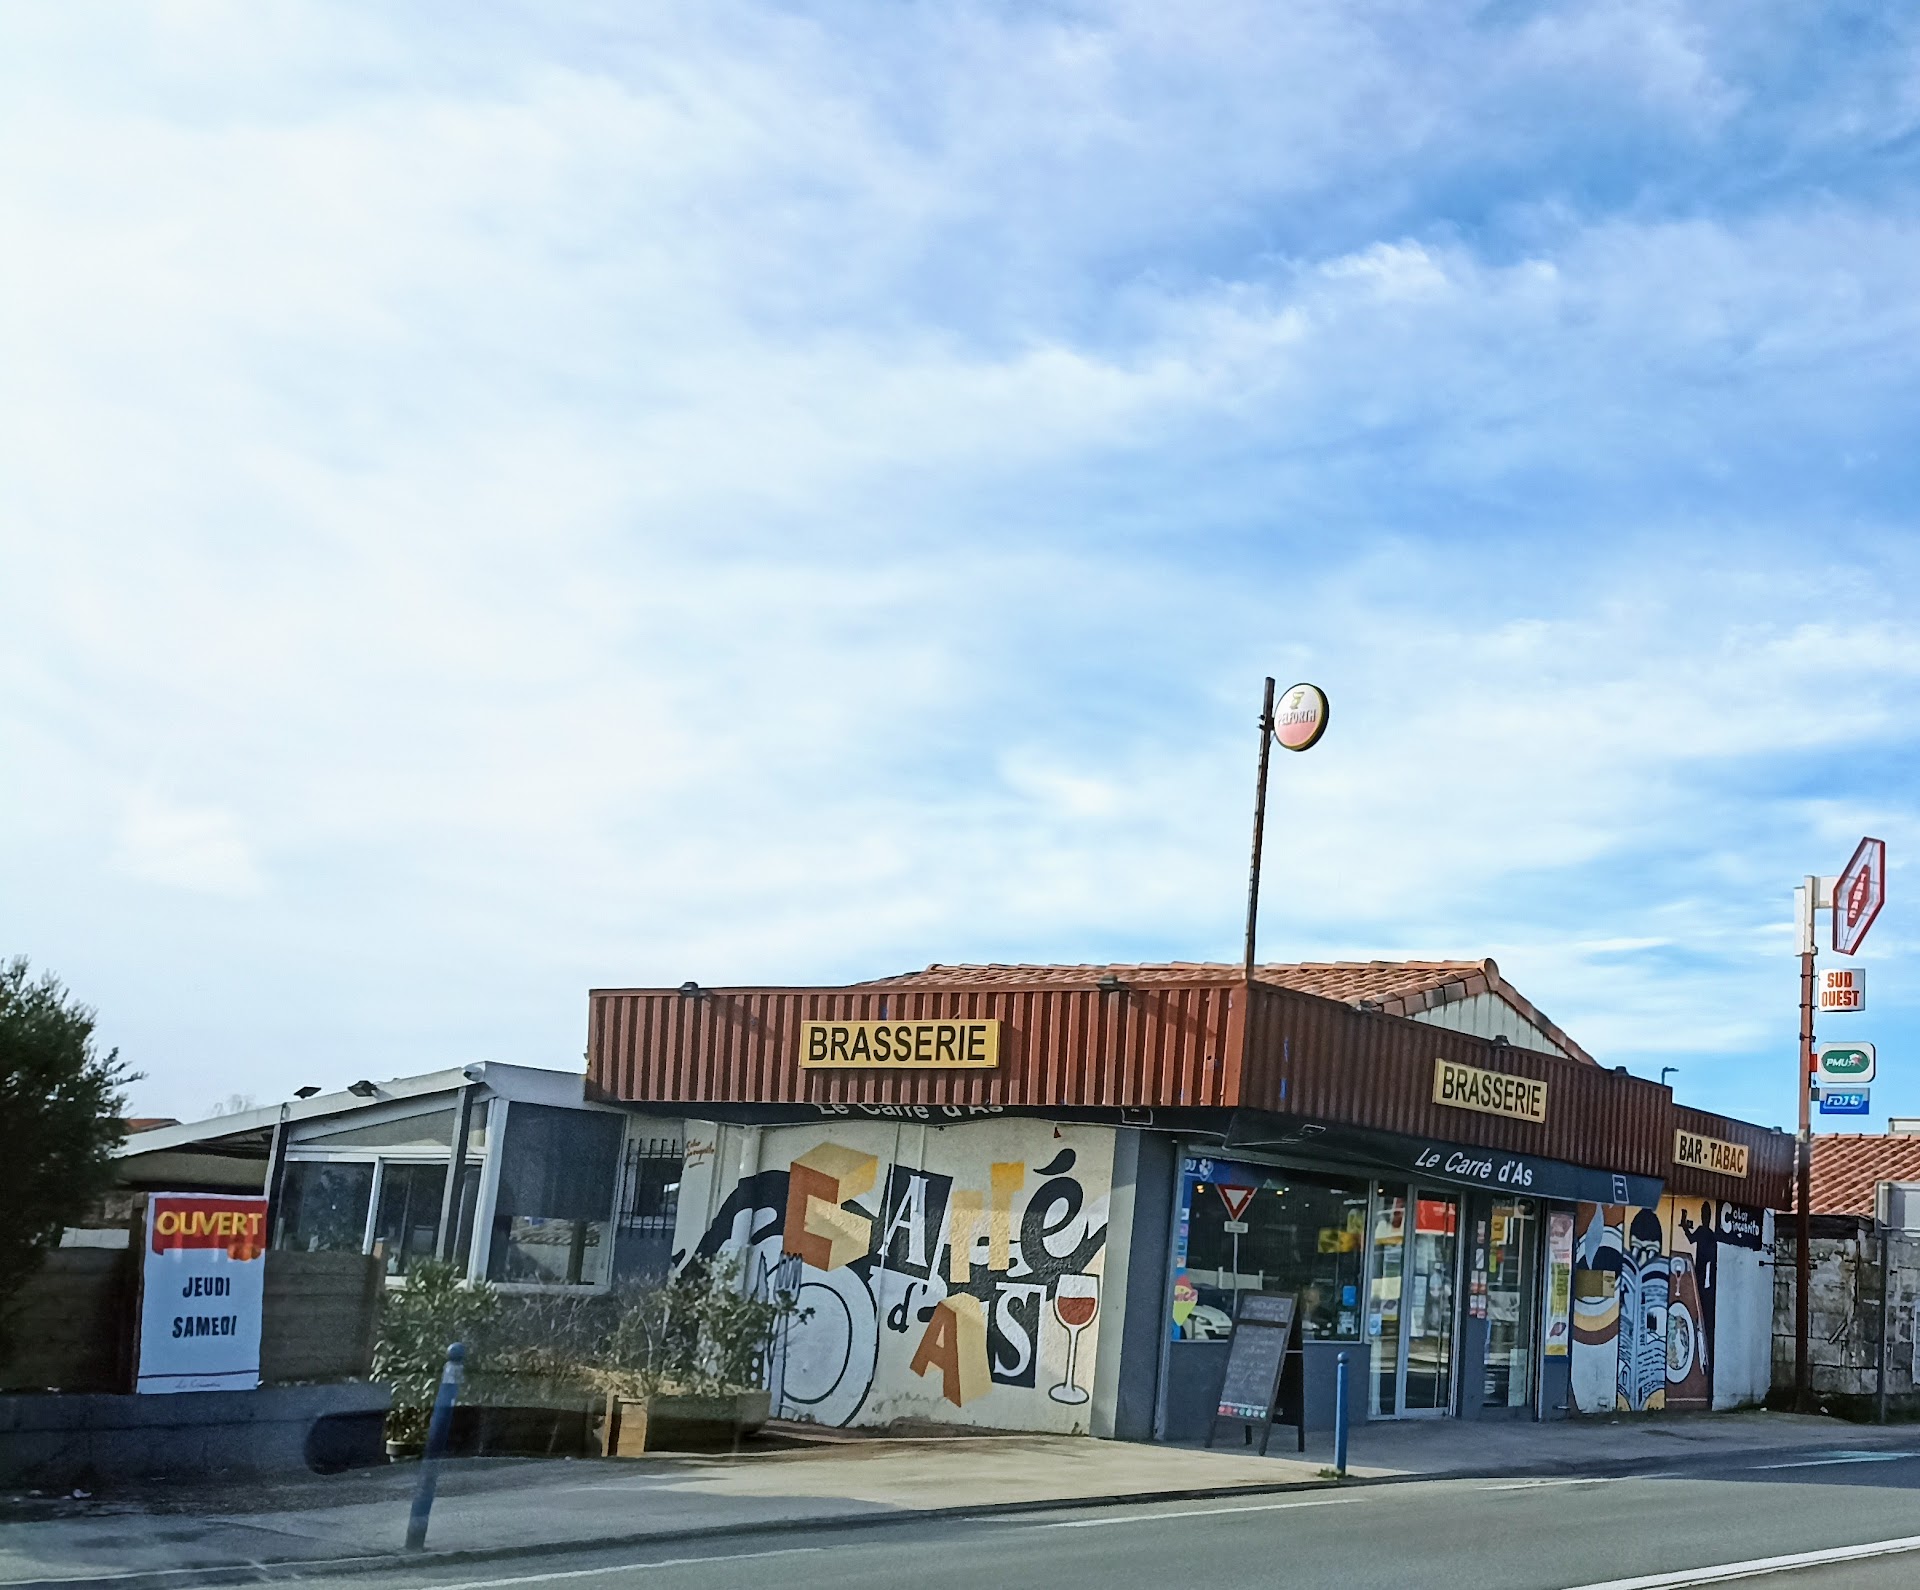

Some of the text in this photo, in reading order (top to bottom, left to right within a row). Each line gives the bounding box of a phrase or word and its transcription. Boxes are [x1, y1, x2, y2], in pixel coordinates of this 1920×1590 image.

[1848, 873, 1867, 919] TABAC
[1827, 971, 1853, 989] SUD
[1821, 990, 1860, 1007] OUEST
[808, 1025, 987, 1062] BRASSERIE
[1826, 1058, 1848, 1067] PMU
[1441, 1065, 1542, 1117] BRASSERIE
[1827, 1095, 1848, 1106] FDJ
[1679, 1135, 1702, 1164] BAR
[1710, 1142, 1745, 1174] TABAC
[1415, 1147, 1533, 1187] Le Carré d'As
[156, 1210, 263, 1236] OUVERT
[182, 1276, 230, 1298] JEUDI
[172, 1315, 237, 1338] SAMEDI
